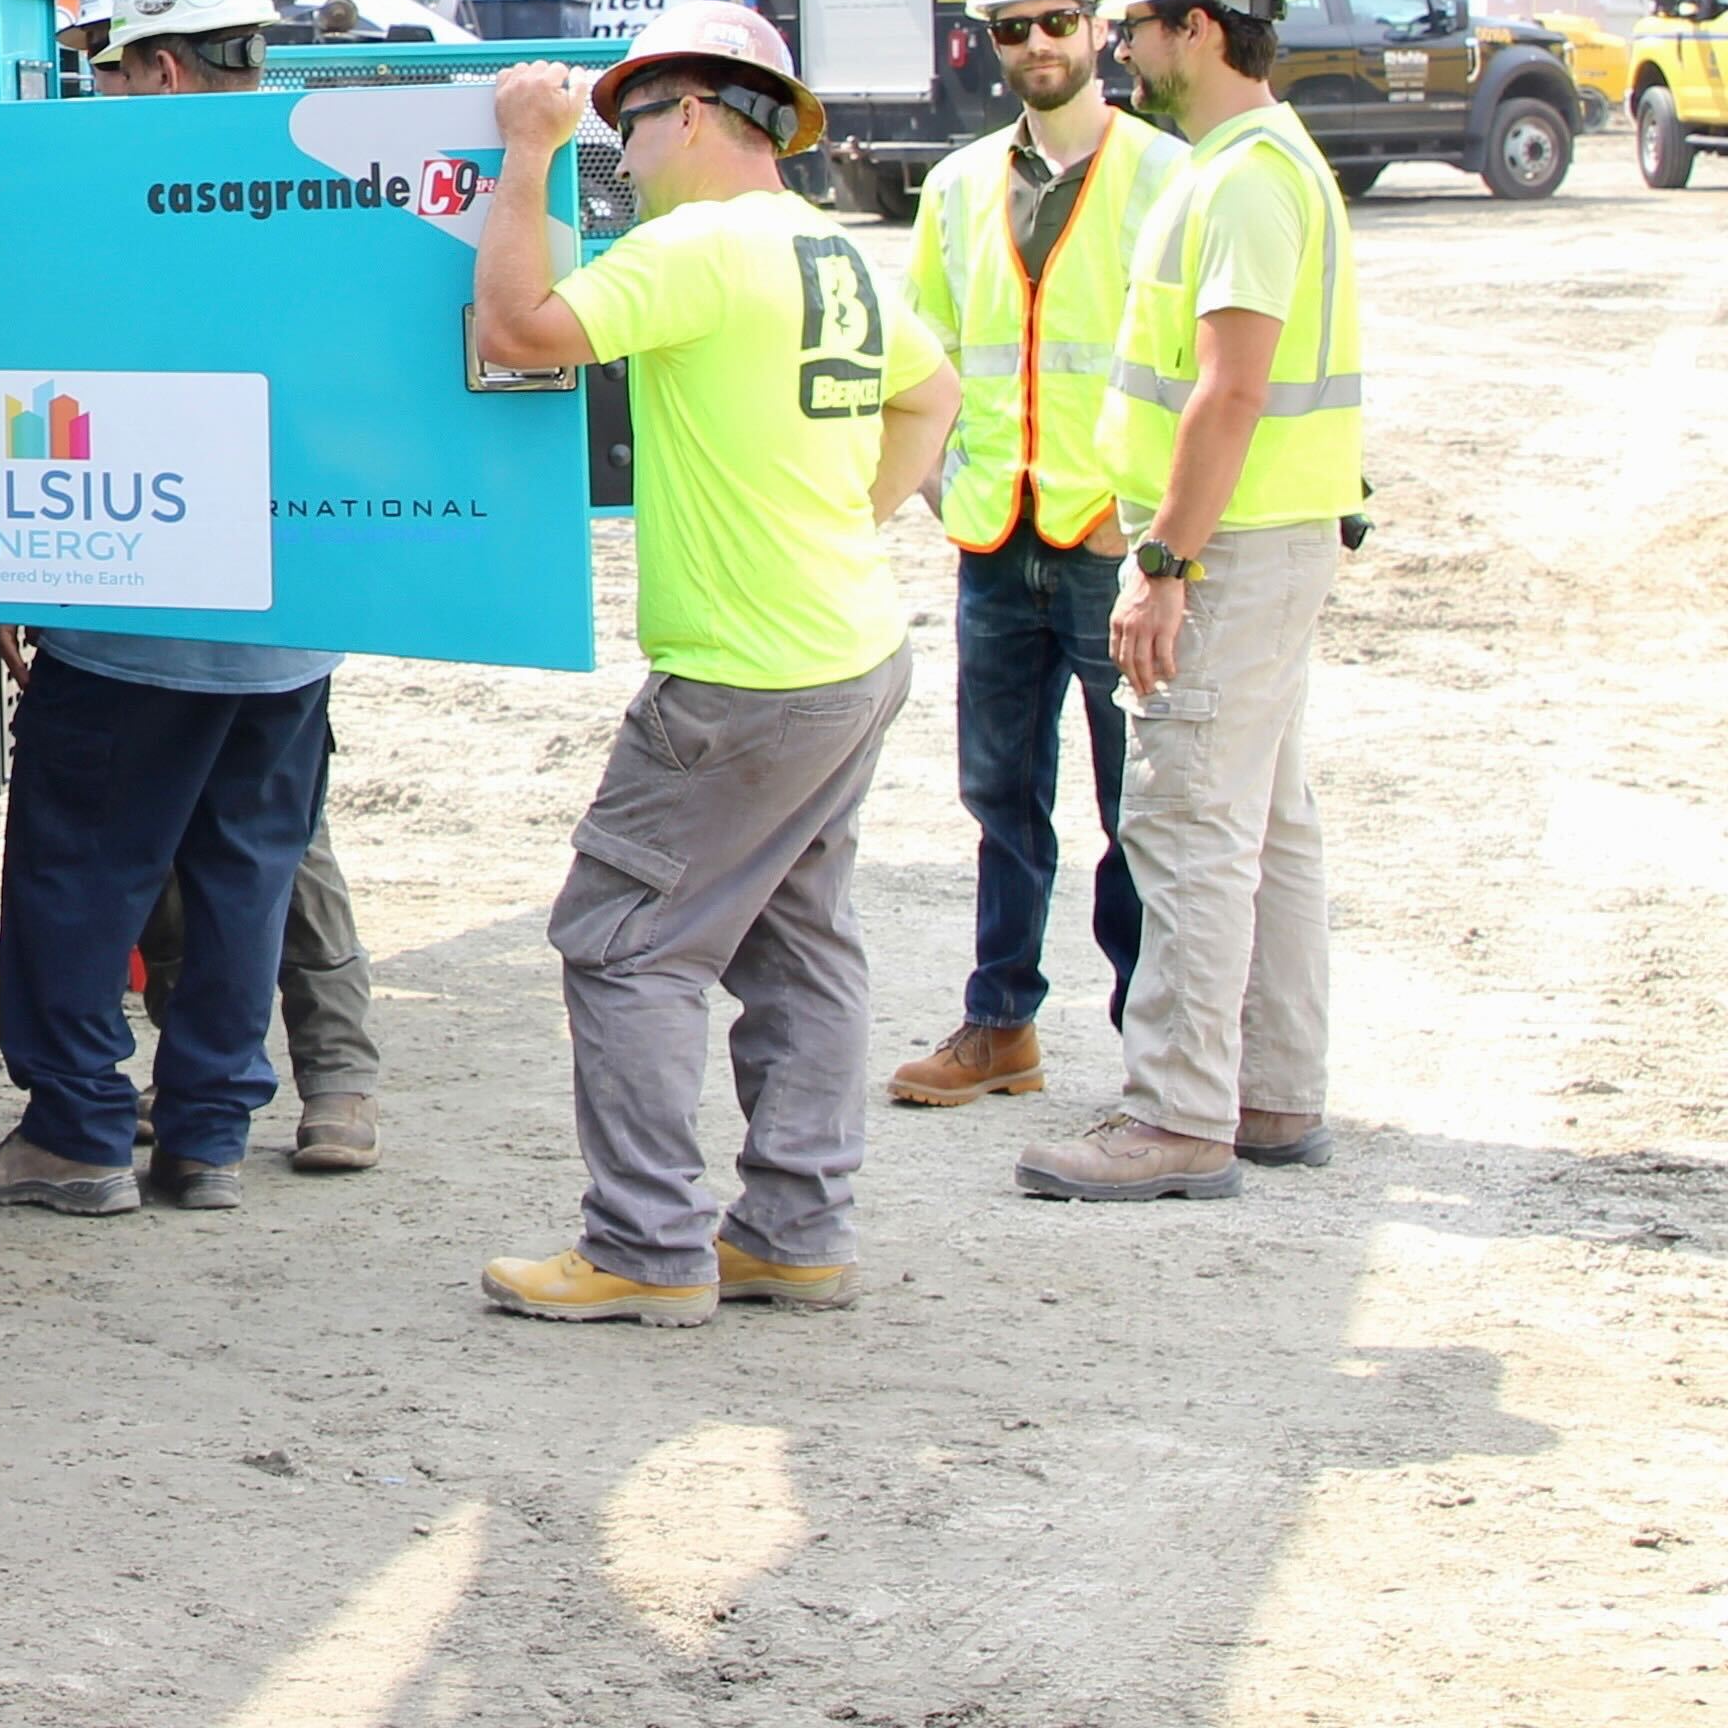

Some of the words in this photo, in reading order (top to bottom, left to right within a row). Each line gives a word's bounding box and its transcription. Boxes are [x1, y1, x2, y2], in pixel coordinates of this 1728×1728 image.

[147, 162, 411, 220] casagrande
[421, 160, 480, 214] C9
[43, 568, 61, 586] by
[66, 570, 94, 584] the
[99, 571, 144, 586] Earth
